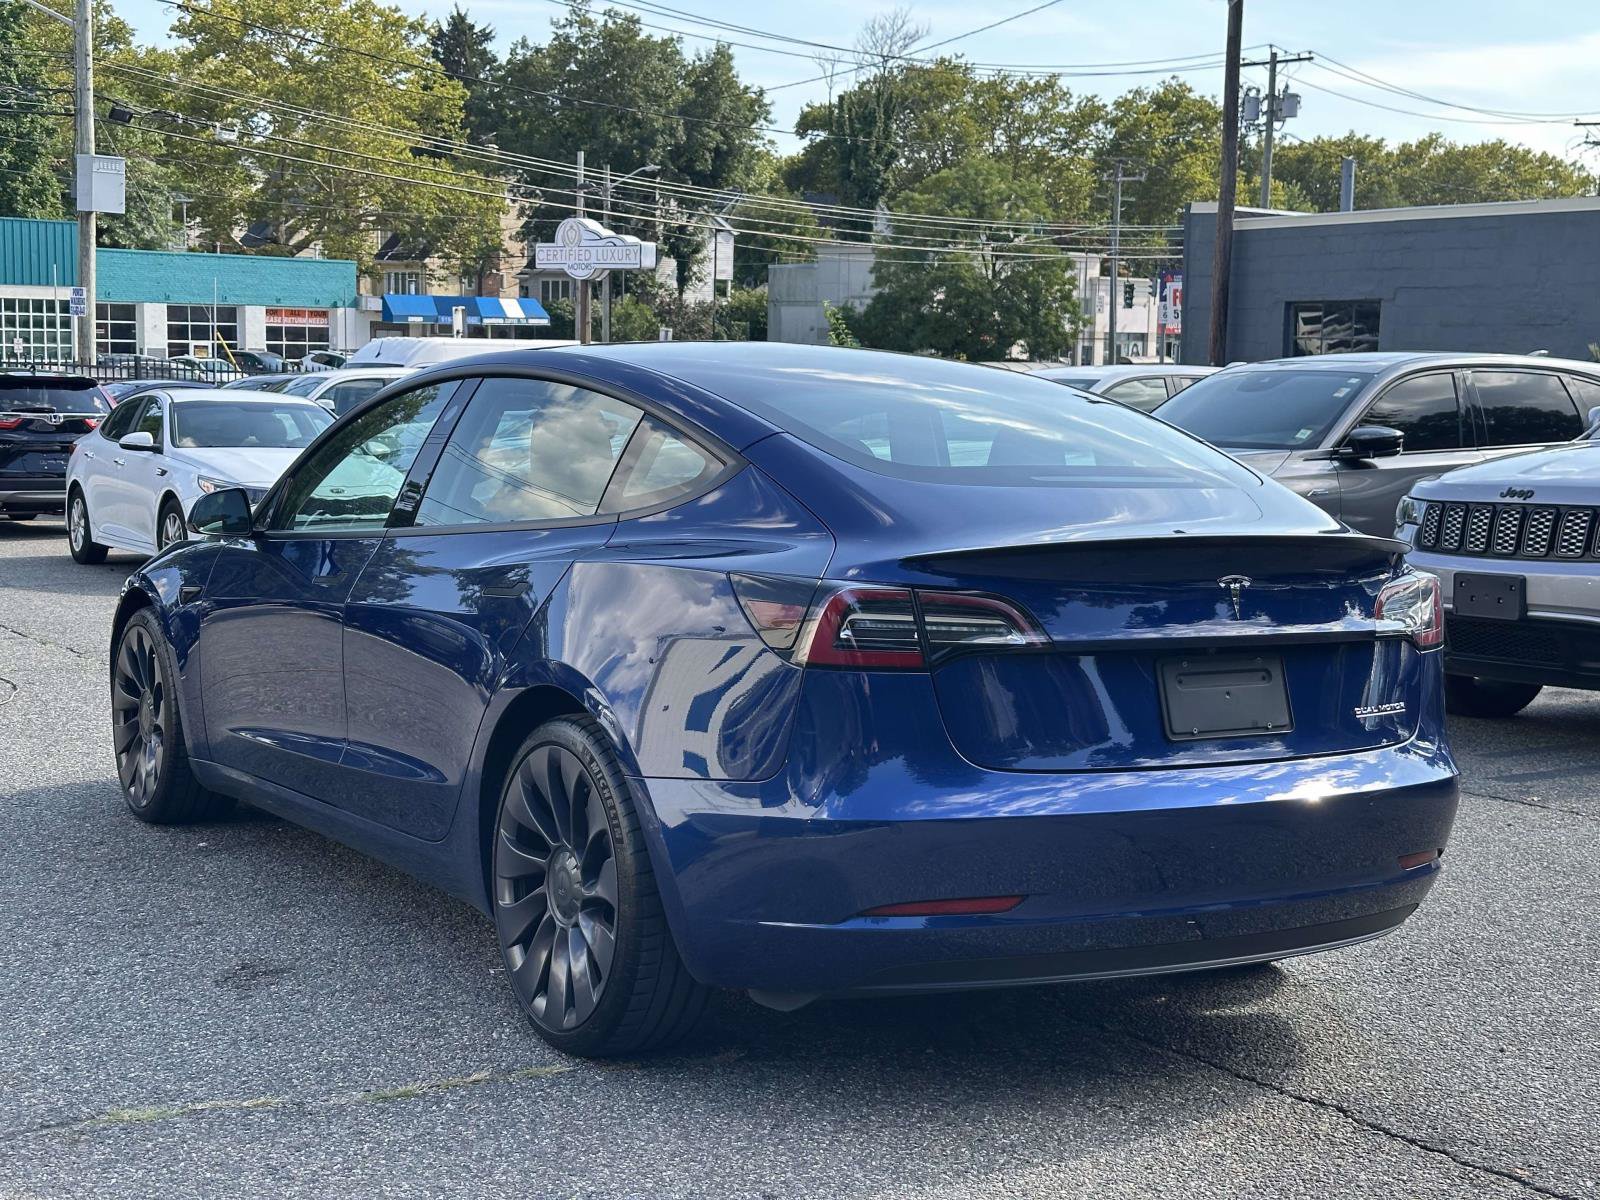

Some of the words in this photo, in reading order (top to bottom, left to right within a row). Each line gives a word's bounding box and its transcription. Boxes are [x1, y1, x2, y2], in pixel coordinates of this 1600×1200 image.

[537, 247, 592, 262] CERTIFIED
[596, 248, 639, 262] LUXURY
[567, 263, 593, 271] MOTORS
[289, 309, 300, 317] ALL
[1499, 486, 1535, 501] Jeep
[1354, 707, 1379, 715] DUAL
[1378, 702, 1406, 712] MOTOR
[590, 760, 622, 839] MICHELIN
